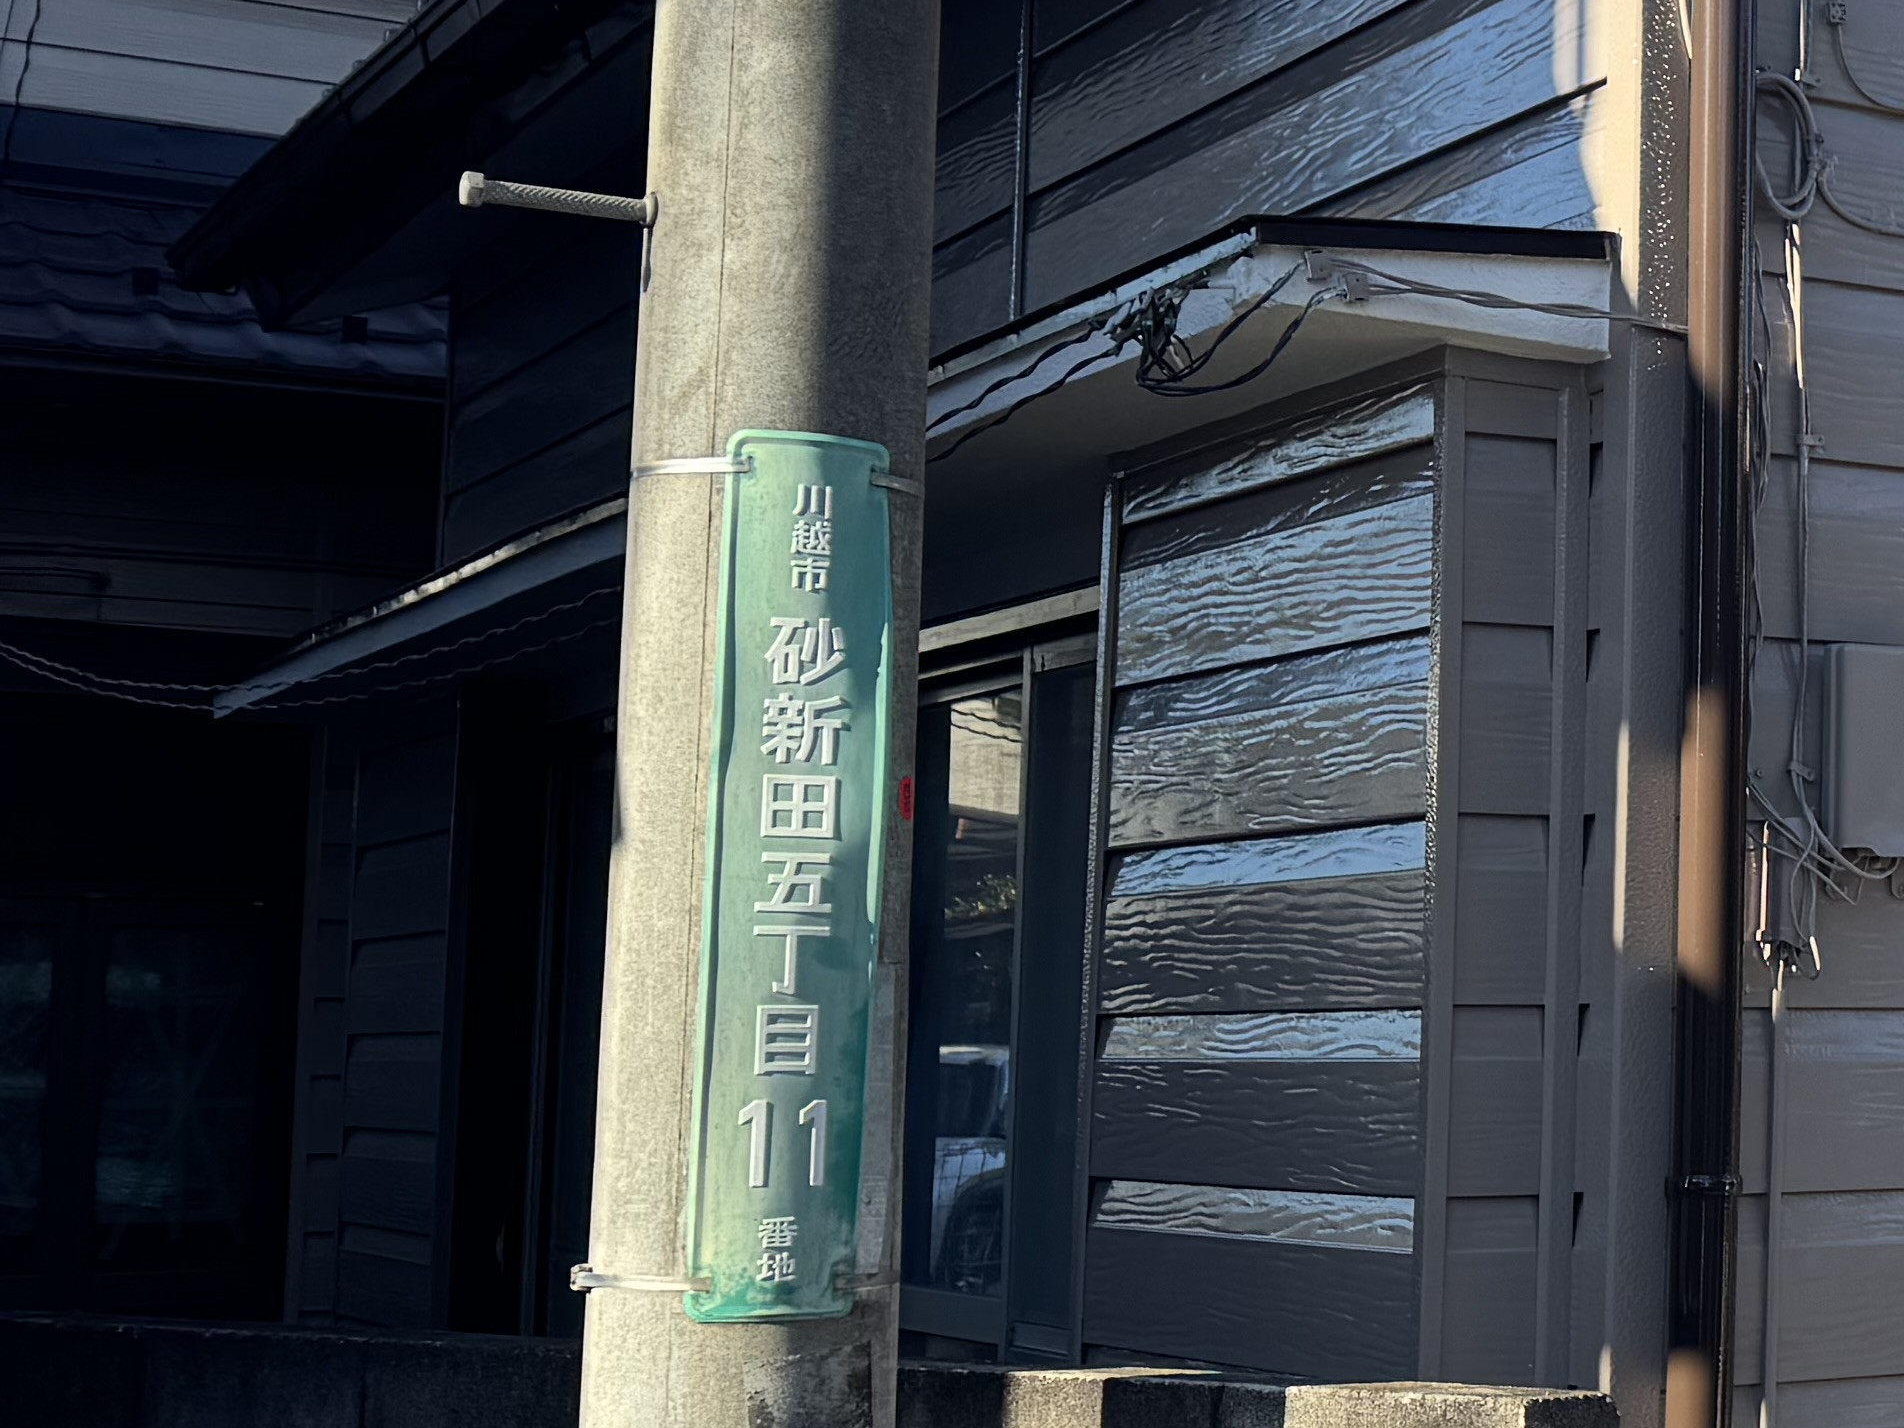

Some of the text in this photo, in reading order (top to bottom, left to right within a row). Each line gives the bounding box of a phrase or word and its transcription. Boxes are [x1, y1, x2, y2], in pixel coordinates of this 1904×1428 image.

[790, 483, 833, 592] 川越市
[753, 617, 847, 1076] 砂新田五丁目
[738, 1099, 828, 1188] 11
[756, 1216, 798, 1282] 番地
